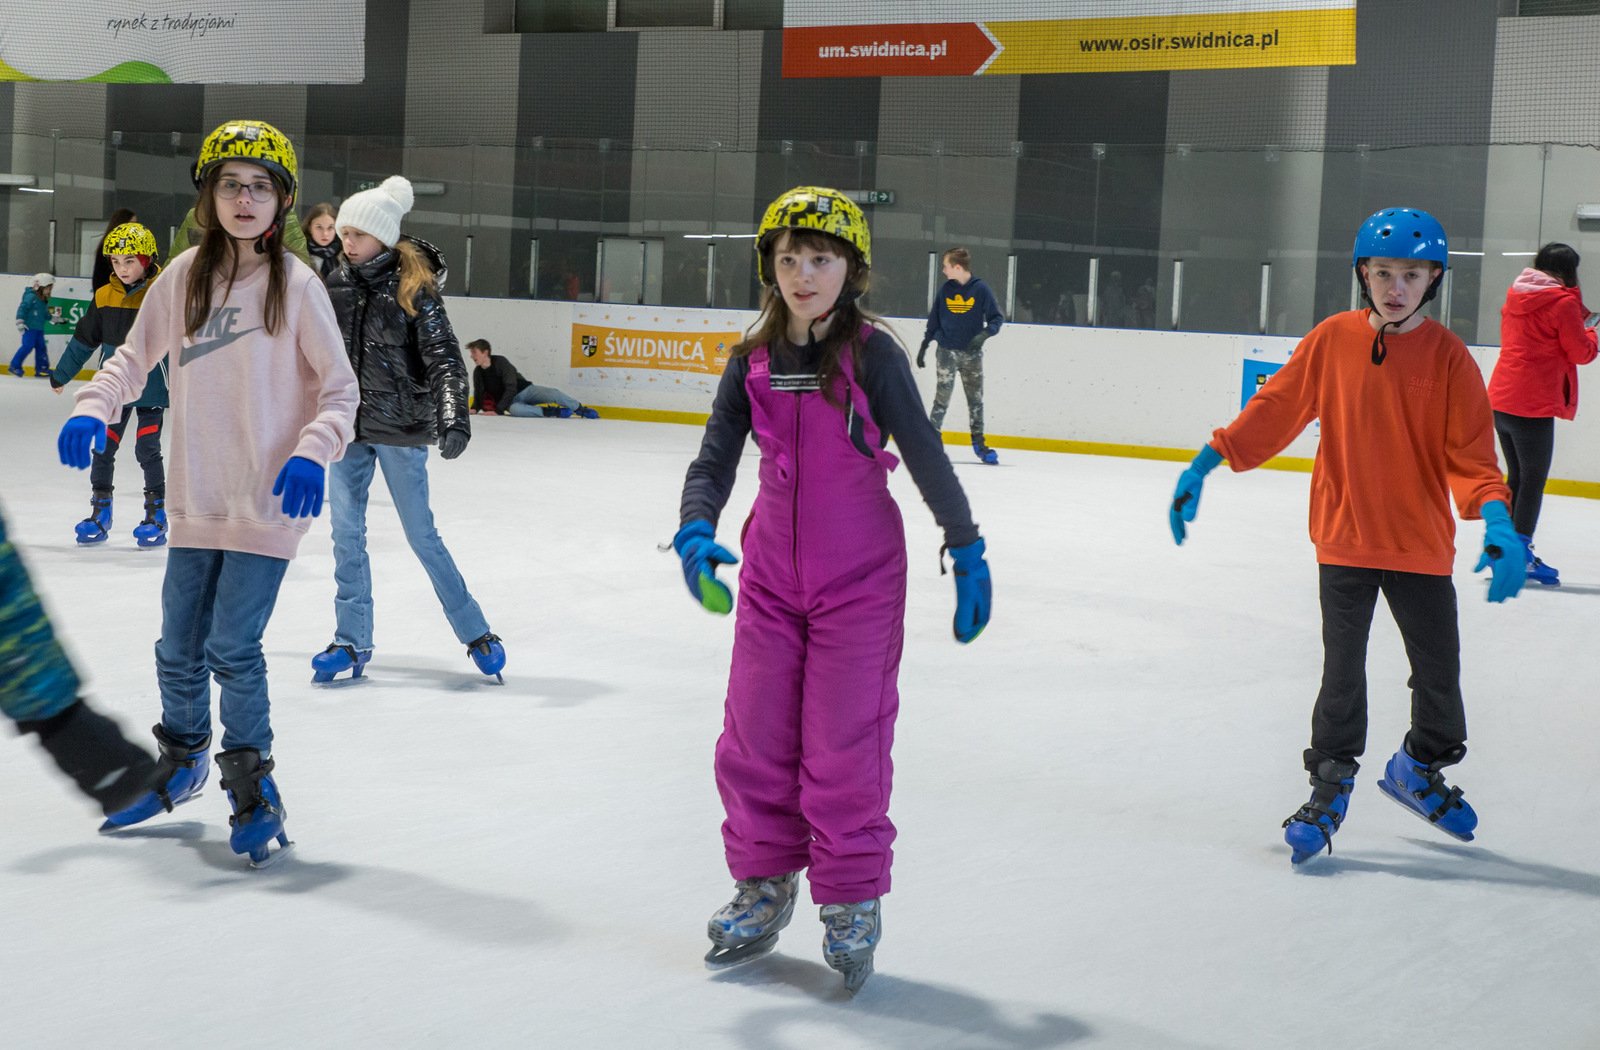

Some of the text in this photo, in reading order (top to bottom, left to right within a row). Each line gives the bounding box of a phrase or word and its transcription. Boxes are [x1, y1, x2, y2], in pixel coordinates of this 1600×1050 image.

[107, 12, 237, 39] rynek z tradycjami
[819, 40, 947, 60] um.swidnica.pl
[1080, 29, 1279, 52] www.osir.swidnica.pl
